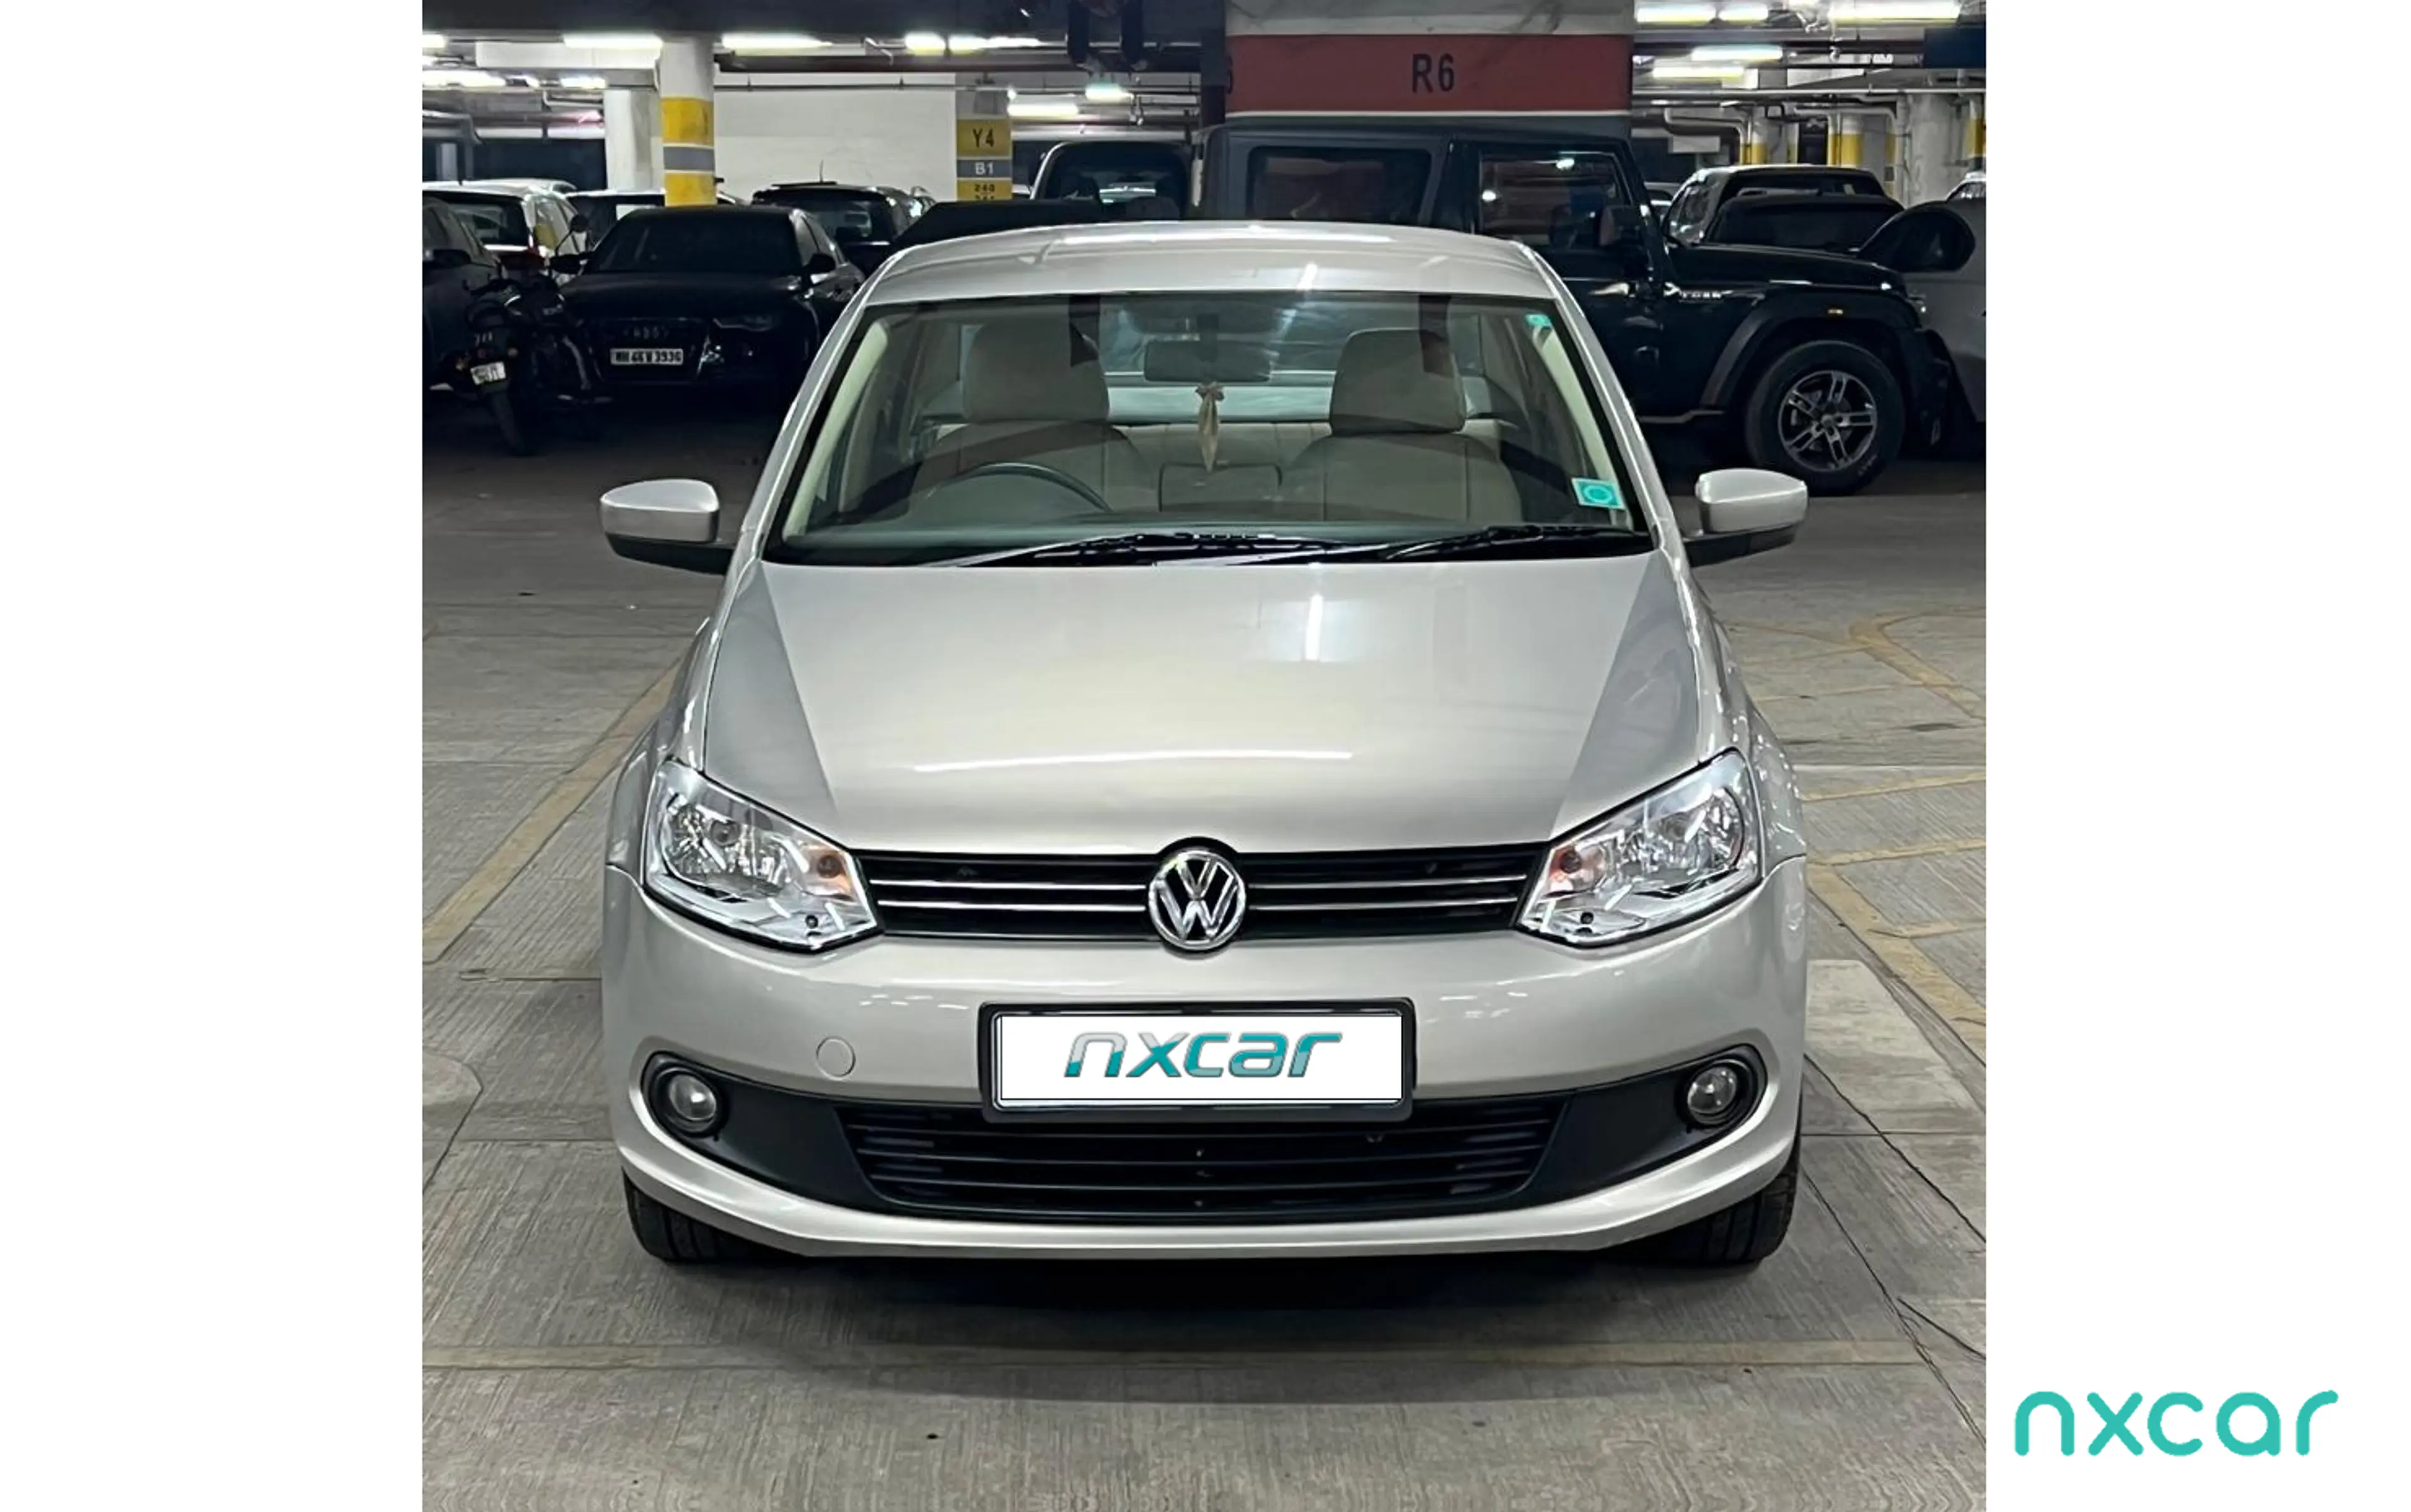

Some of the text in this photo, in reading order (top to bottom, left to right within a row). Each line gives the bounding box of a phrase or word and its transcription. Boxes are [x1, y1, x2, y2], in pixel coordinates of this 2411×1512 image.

[1412, 53, 1455, 94] R6
[973, 128, 994, 148] Y4
[974, 162, 993, 175] B1
